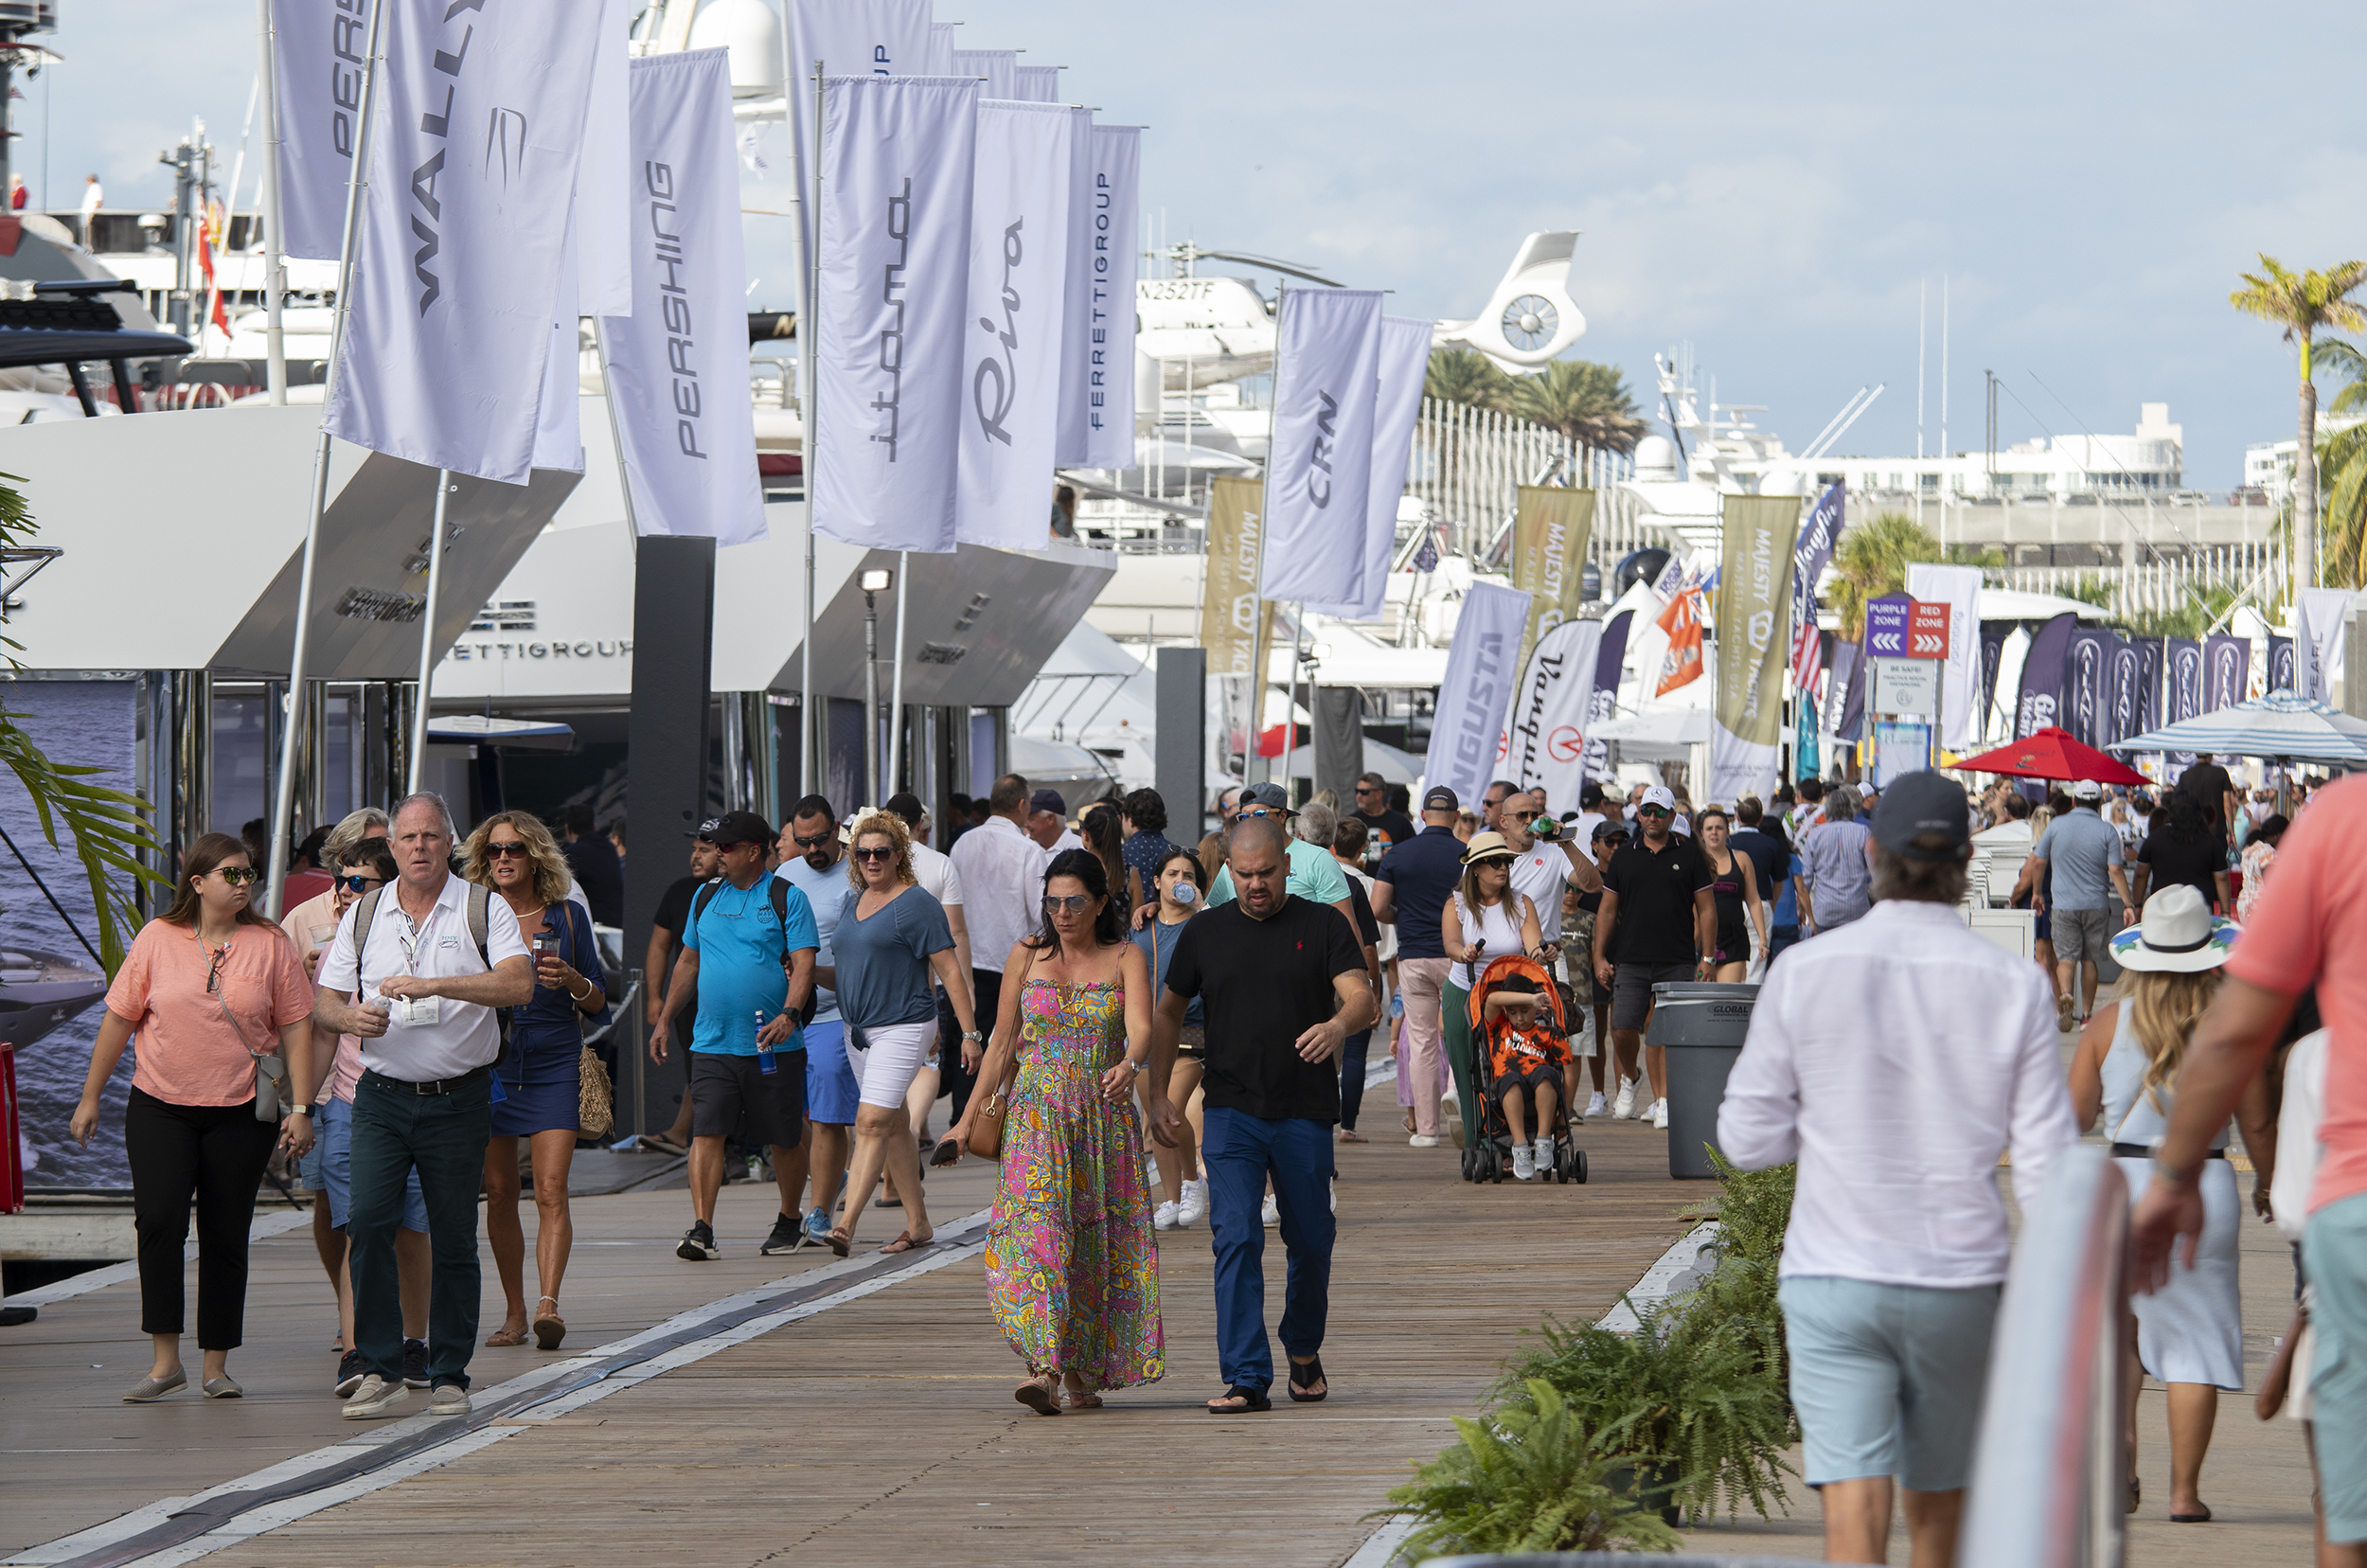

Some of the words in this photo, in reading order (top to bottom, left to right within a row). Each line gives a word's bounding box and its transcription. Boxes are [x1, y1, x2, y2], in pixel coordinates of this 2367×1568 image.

[646, 160, 707, 460] PERSHING
[973, 215, 1023, 448] Riva
[1091, 172, 1112, 432] FERRETTIGROUP
[1308, 389, 1339, 510] CRN
[1237, 510, 1259, 587] MAJESTY
[1543, 522, 1567, 603] MAJESTY
[1752, 527, 1772, 603] MAJESTY
[1869, 603, 1908, 615] PURPLE
[1874, 615, 1902, 627] ZONE
[1915, 617, 1945, 629] ZONE
[1919, 606, 1942, 616] RED
[447, 639, 634, 661] ETTIGROUP
[2309, 632, 2323, 701] PEARL
[1450, 631, 1504, 798] NGUSTA
[1517, 652, 1564, 791] Vanqui
[1714, 1005, 1749, 1013] GLOBAL
